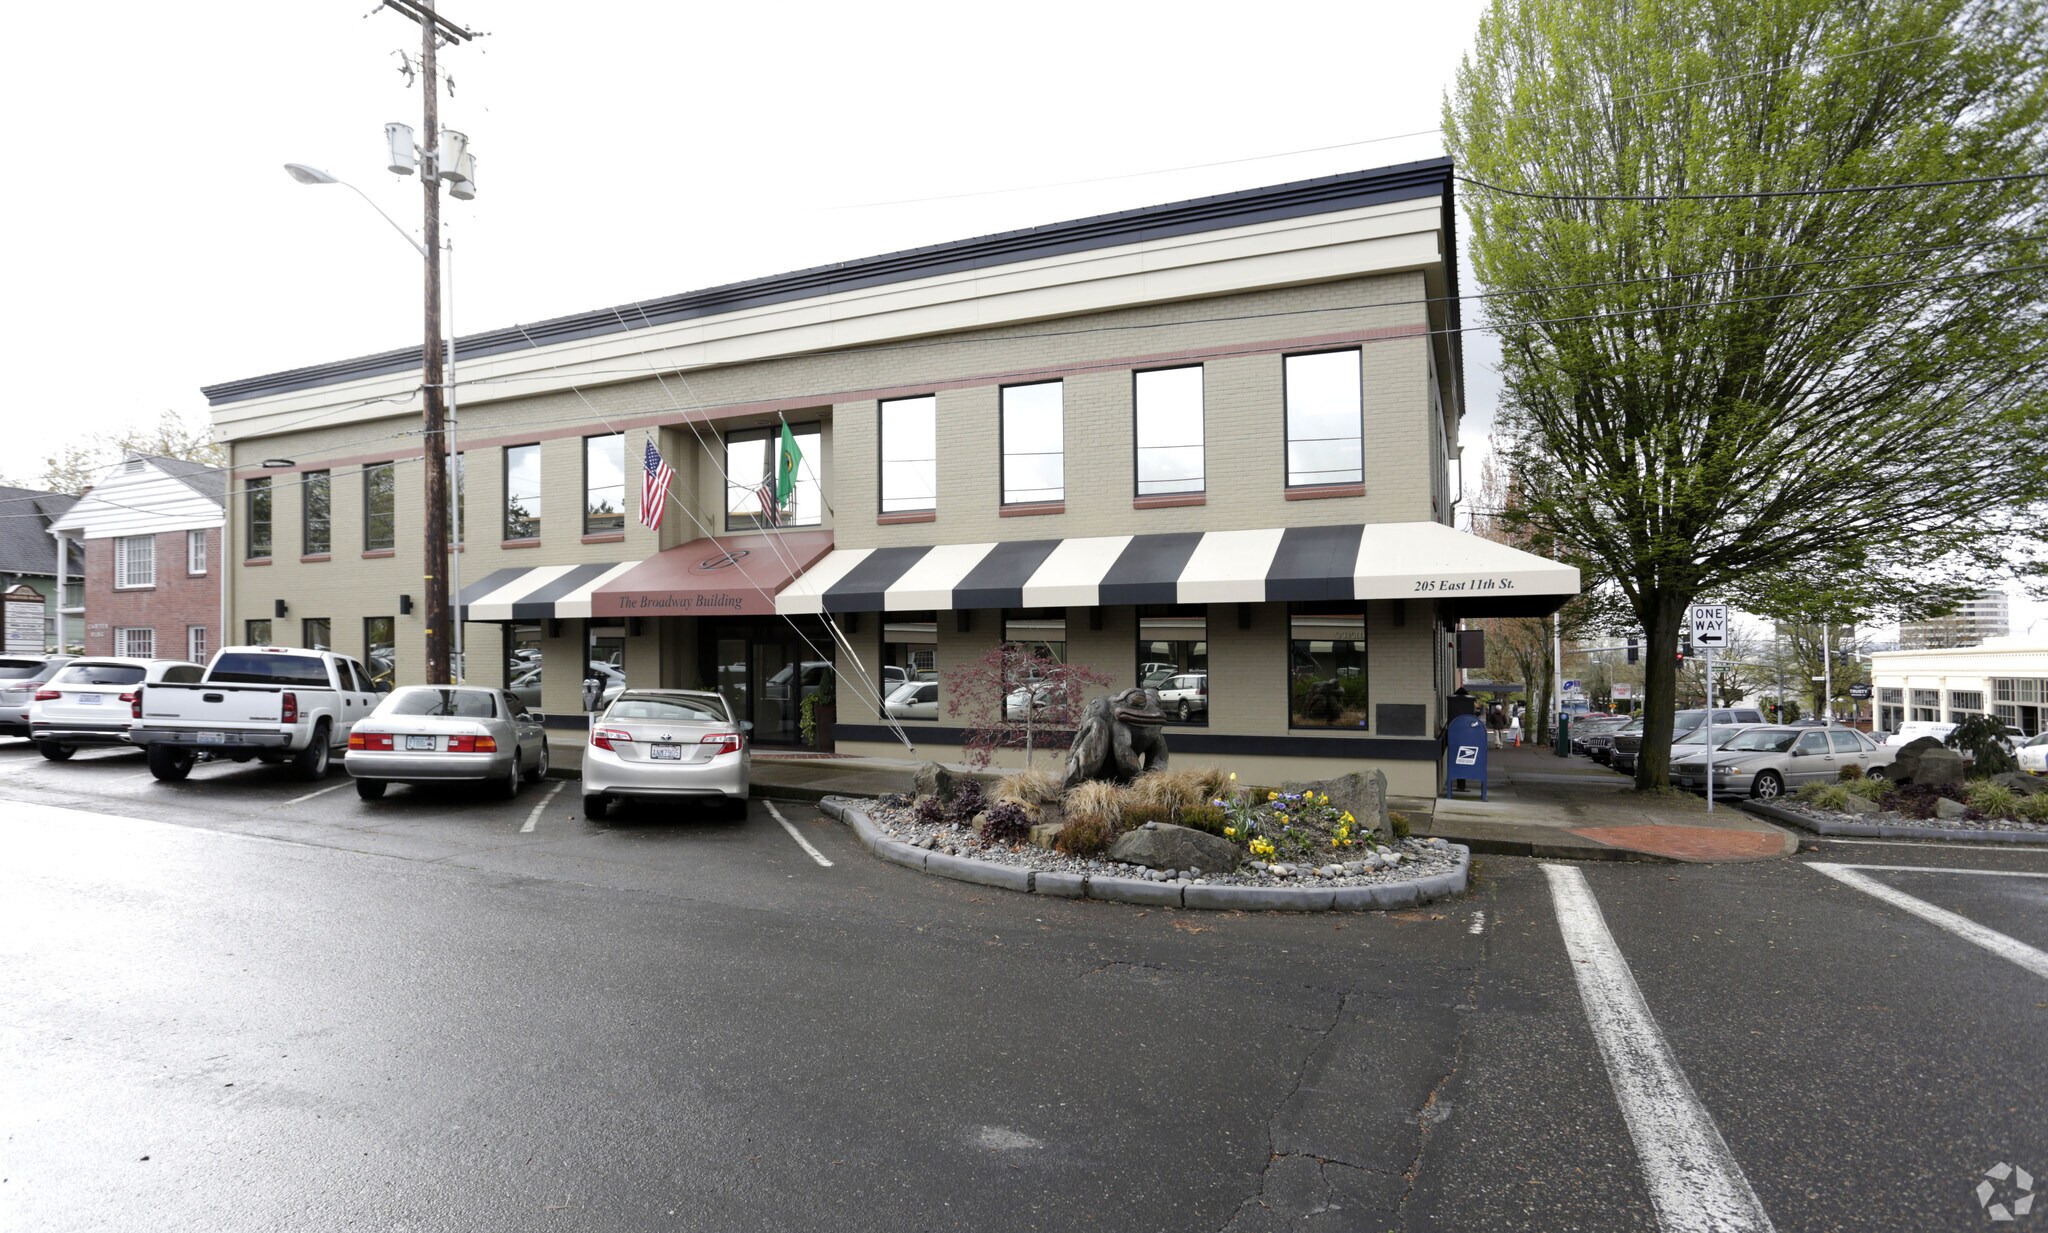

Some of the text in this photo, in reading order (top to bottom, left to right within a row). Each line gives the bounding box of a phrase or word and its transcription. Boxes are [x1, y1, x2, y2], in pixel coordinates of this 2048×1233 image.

[1414, 577, 1515, 592] 205 East 11th St.
[618, 593, 743, 611] The Broadway Building
[1695, 608, 1723, 619] ONE
[1695, 620, 1724, 631] WAY
